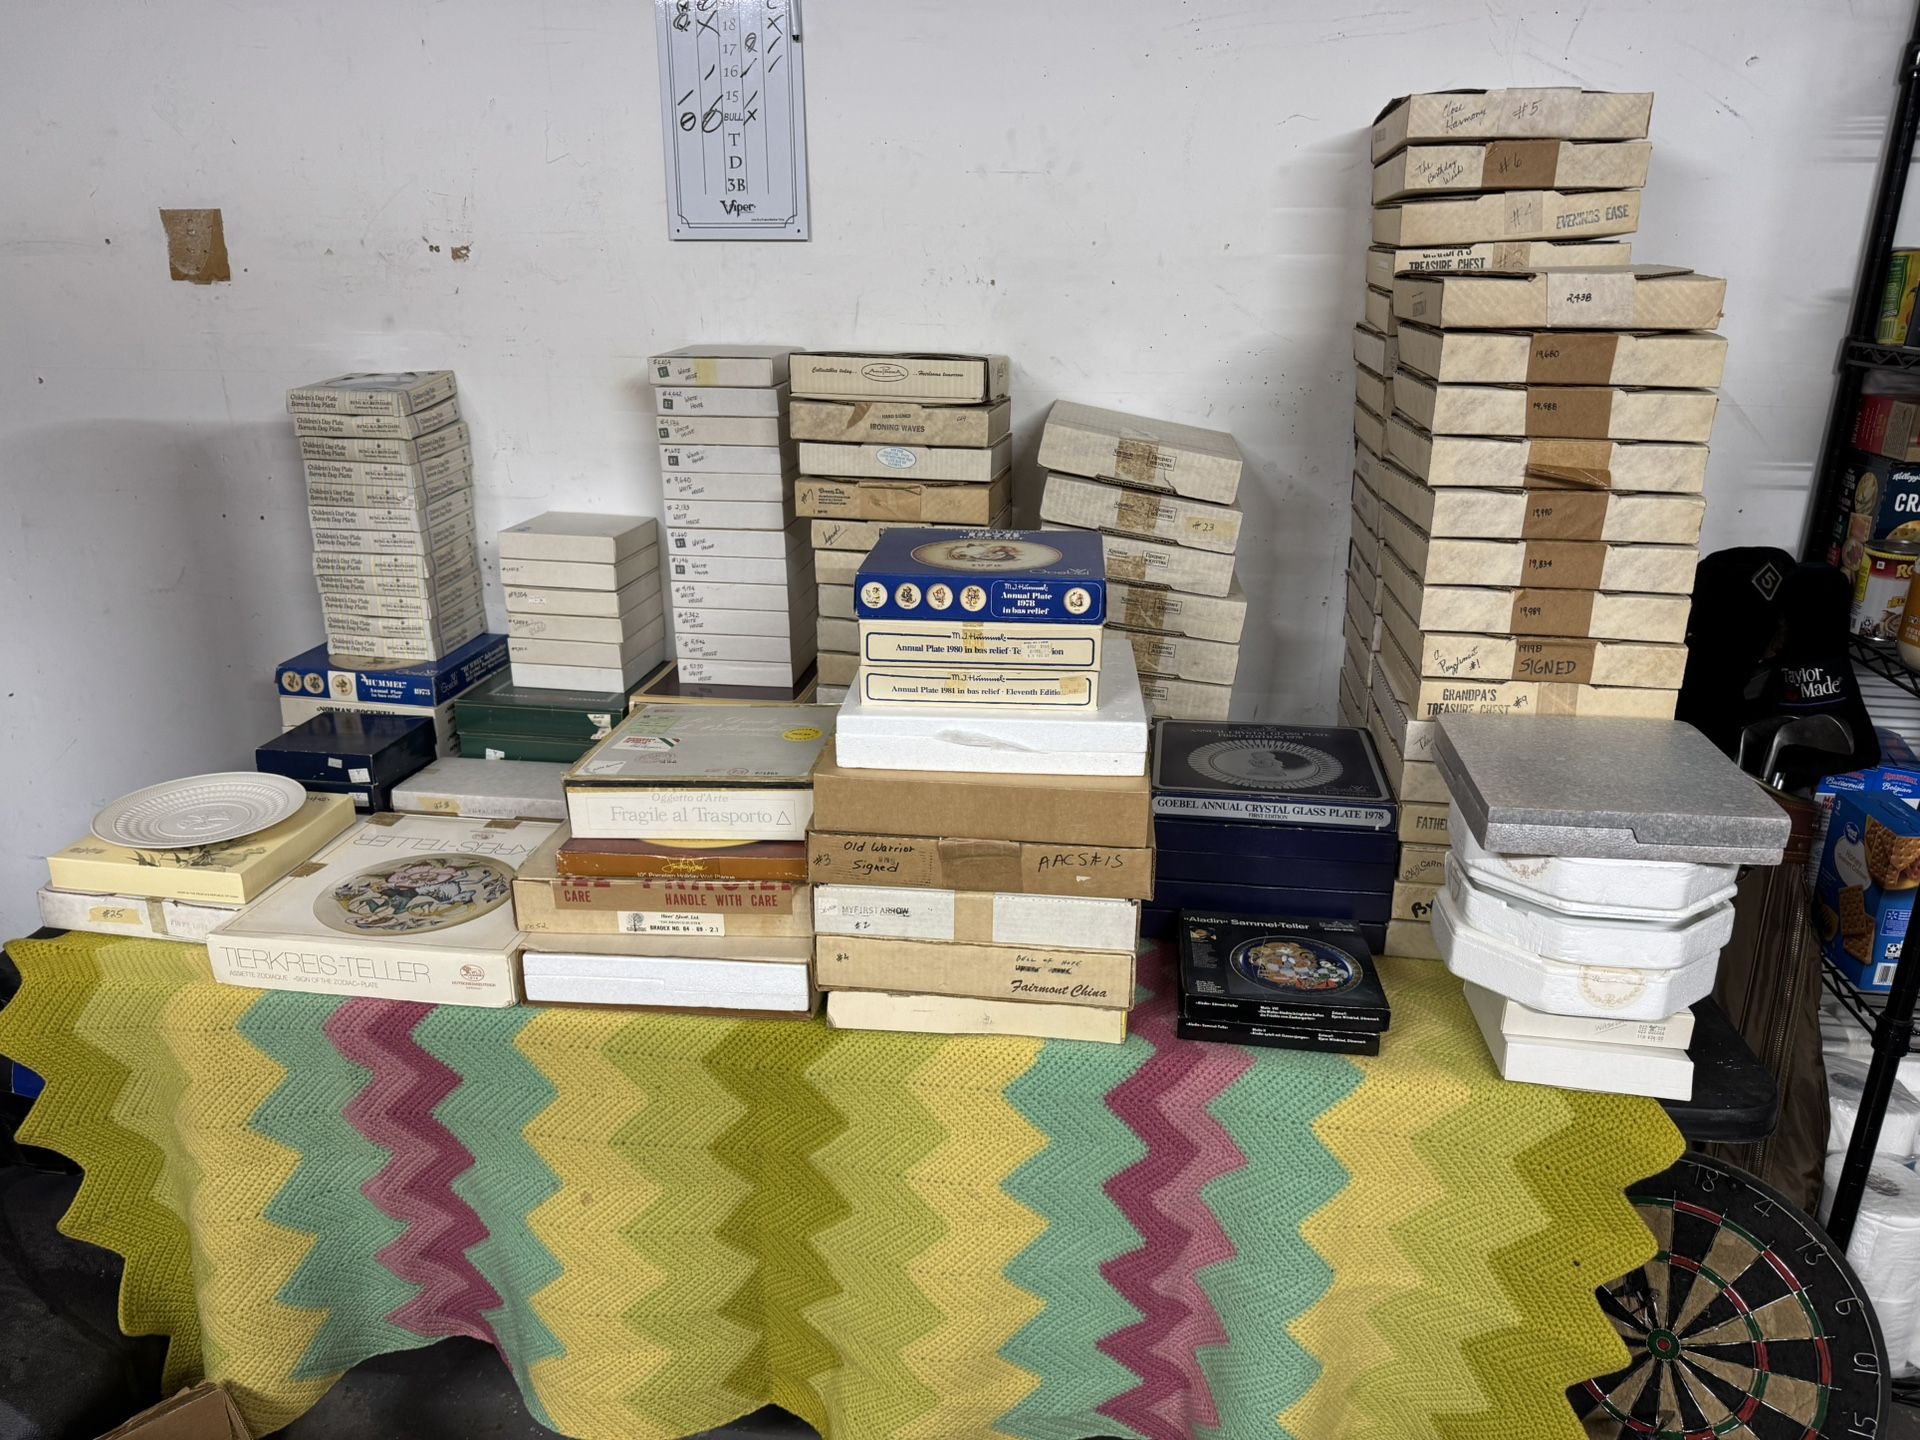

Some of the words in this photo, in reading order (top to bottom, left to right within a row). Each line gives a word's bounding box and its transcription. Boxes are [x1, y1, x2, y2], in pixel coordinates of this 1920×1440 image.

[722, 19, 736, 31] 18
[722, 44, 737, 56] 17
[723, 65, 739, 78] 16
[726, 90, 739, 103] 15
[724, 112, 744, 122] BULL
[728, 132, 741, 147] T
[729, 155, 743, 170] D
[727, 178, 746, 192] 3B
[720, 200, 756, 217] Viper
[1605, 204, 1630, 222] EASE
[1457, 257, 1486, 270] CHEST
[870, 423, 900, 432] IRONING
[901, 424, 926, 433] WAVES
[1032, 592, 1053, 600] Plate
[1002, 606, 1011, 614] in
[1012, 606, 1026, 614] bas
[1027, 607, 1050, 615] relief
[896, 644, 924, 653] Annual
[926, 644, 945, 654] Plate
[946, 644, 964, 654] 1980
[964, 646, 973, 654] in
[974, 645, 988, 655] bas
[988, 646, 1008, 656] relief
[1518, 657, 1578, 676] SIGNED
[1781, 666, 1824, 687] Taylor
[892, 685, 919, 694] Annual
[920, 686, 939, 694] Plate
[940, 686, 956, 694] 1981
[957, 687, 966, 695] in
[967, 687, 980, 695] bas
[981, 687, 1001, 696] relief
[1006, 688, 1038, 696] Eleventh
[1442, 687, 1498, 702] GRANDPA'S
[1800, 675, 1842, 699] Made
[1426, 702, 1474, 716] TREASURE
[1825, 776, 1865, 790] Buttermilk
[1882, 782, 1913, 794] Belgian
[651, 792, 694, 804] Oggetto
[696, 792, 729, 803] d'Arte
[610, 806, 668, 826] Fragile
[672, 807, 688, 823] al
[692, 807, 773, 827] Trasporto
[1156, 798, 1200, 811] GOEBEL
[1200, 800, 1243, 812] ANNUAL
[1244, 802, 1290, 816] CRYSTAL
[1292, 805, 1327, 817] GLASS
[1328, 807, 1362, 819] PLATE
[1363, 809, 1385, 820] 1978
[844, 840, 866, 852] Old
[871, 842, 915, 853] Warrior
[852, 859, 900, 876] Signed
[564, 889, 592, 904] CARE
[665, 893, 707, 906] HANDLE
[715, 894, 742, 906] WITH
[751, 894, 778, 908] CARE
[102, 908, 124, 918] #25
[650, 924, 670, 932] BRADEX
[219, 946, 433, 984] TIERKREIS-TELLER
[229, 970, 256, 980] ASSIETTE
[256, 972, 288, 982] ZODIAQUE
[320, 977, 332, 985] THE
[1010, 979, 1069, 996] Fairmont
[1070, 984, 1108, 998] China
[1689, 1163, 1720, 1193] 18
[1753, 1199, 1775, 1218] 4
